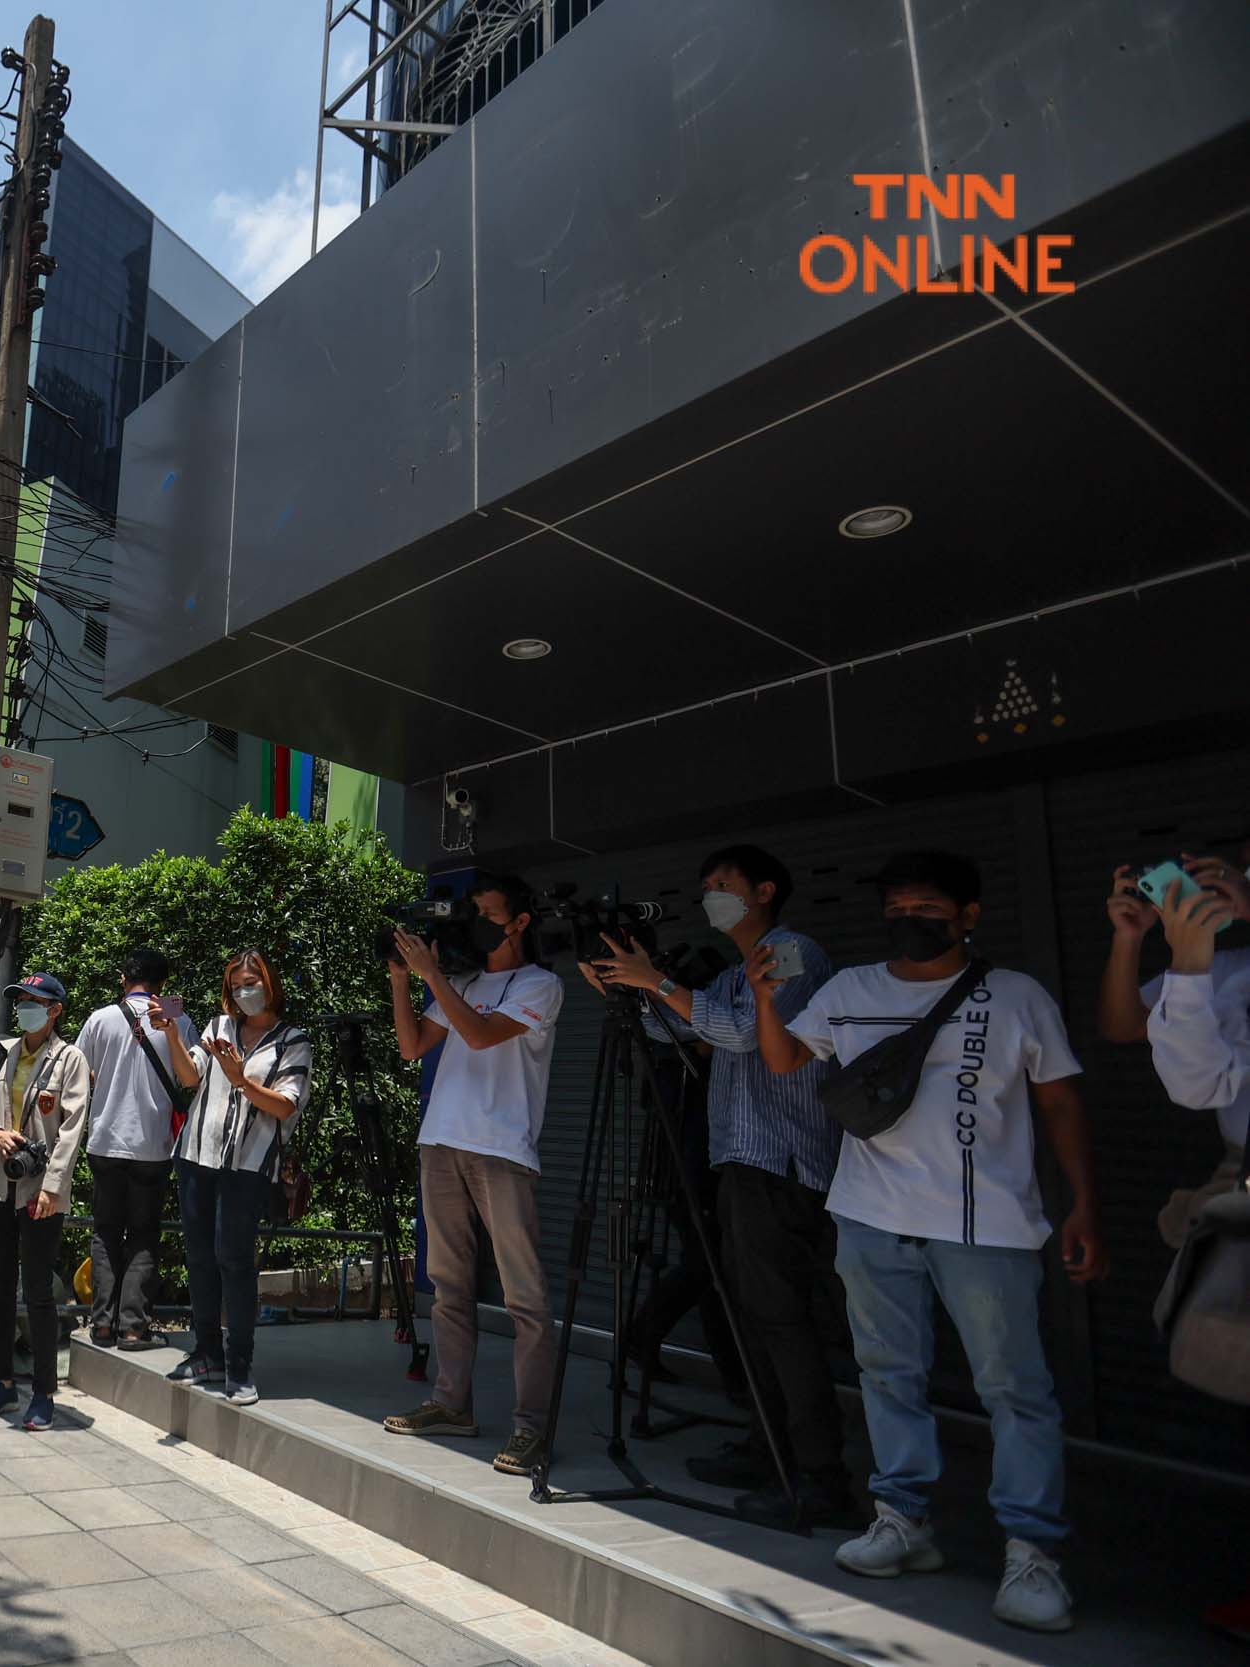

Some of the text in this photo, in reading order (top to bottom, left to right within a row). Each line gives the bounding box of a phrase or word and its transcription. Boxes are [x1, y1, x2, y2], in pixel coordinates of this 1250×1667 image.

[65, 810, 82, 840] 2
[956, 1010, 990, 1106] DOUBLE
[956, 1111, 976, 1147] CC
